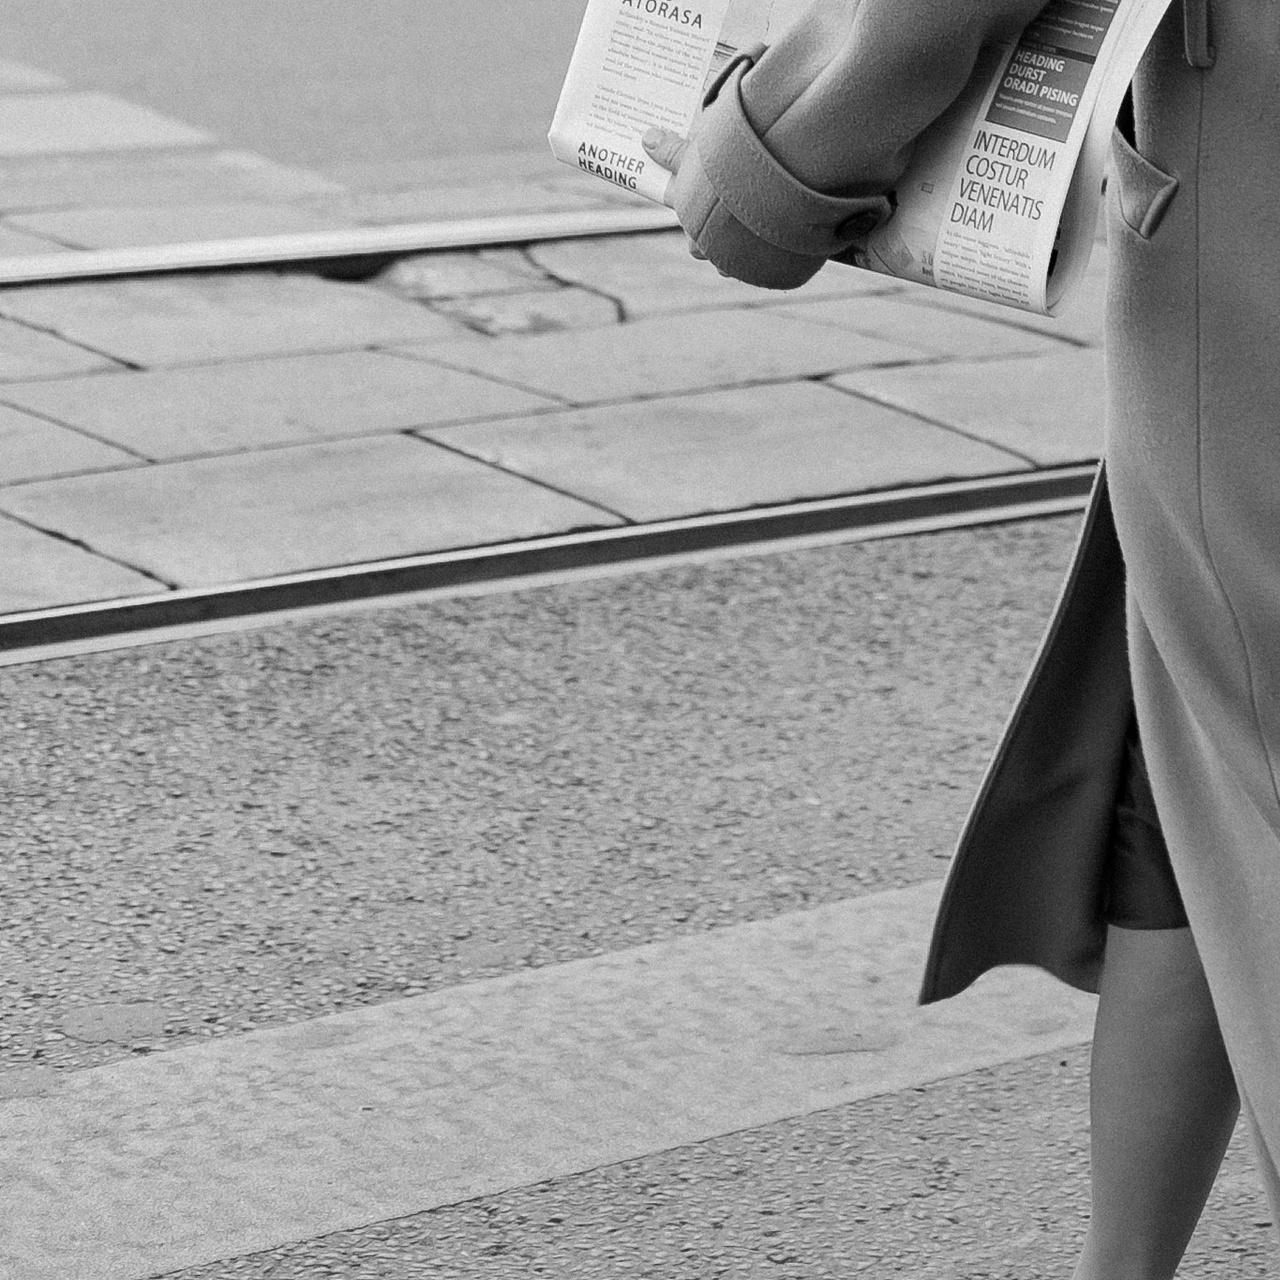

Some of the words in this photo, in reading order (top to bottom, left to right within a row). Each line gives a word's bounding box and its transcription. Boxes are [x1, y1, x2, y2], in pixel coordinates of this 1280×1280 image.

[1009, 63, 1047, 82] DURST
[1015, 50, 1066, 72] HEADING
[1004, 76, 1039, 96] ORADI
[1040, 85, 1079, 107] PISING
[578, 142, 645, 174] ANOTHER
[973, 130, 1056, 171] INTERDUM
[578, 156, 637, 189] HEADING
[966, 155, 1028, 190] COSTUR
[960, 178, 1044, 220] VENENATIS
[950, 202, 994, 233] DIAM
